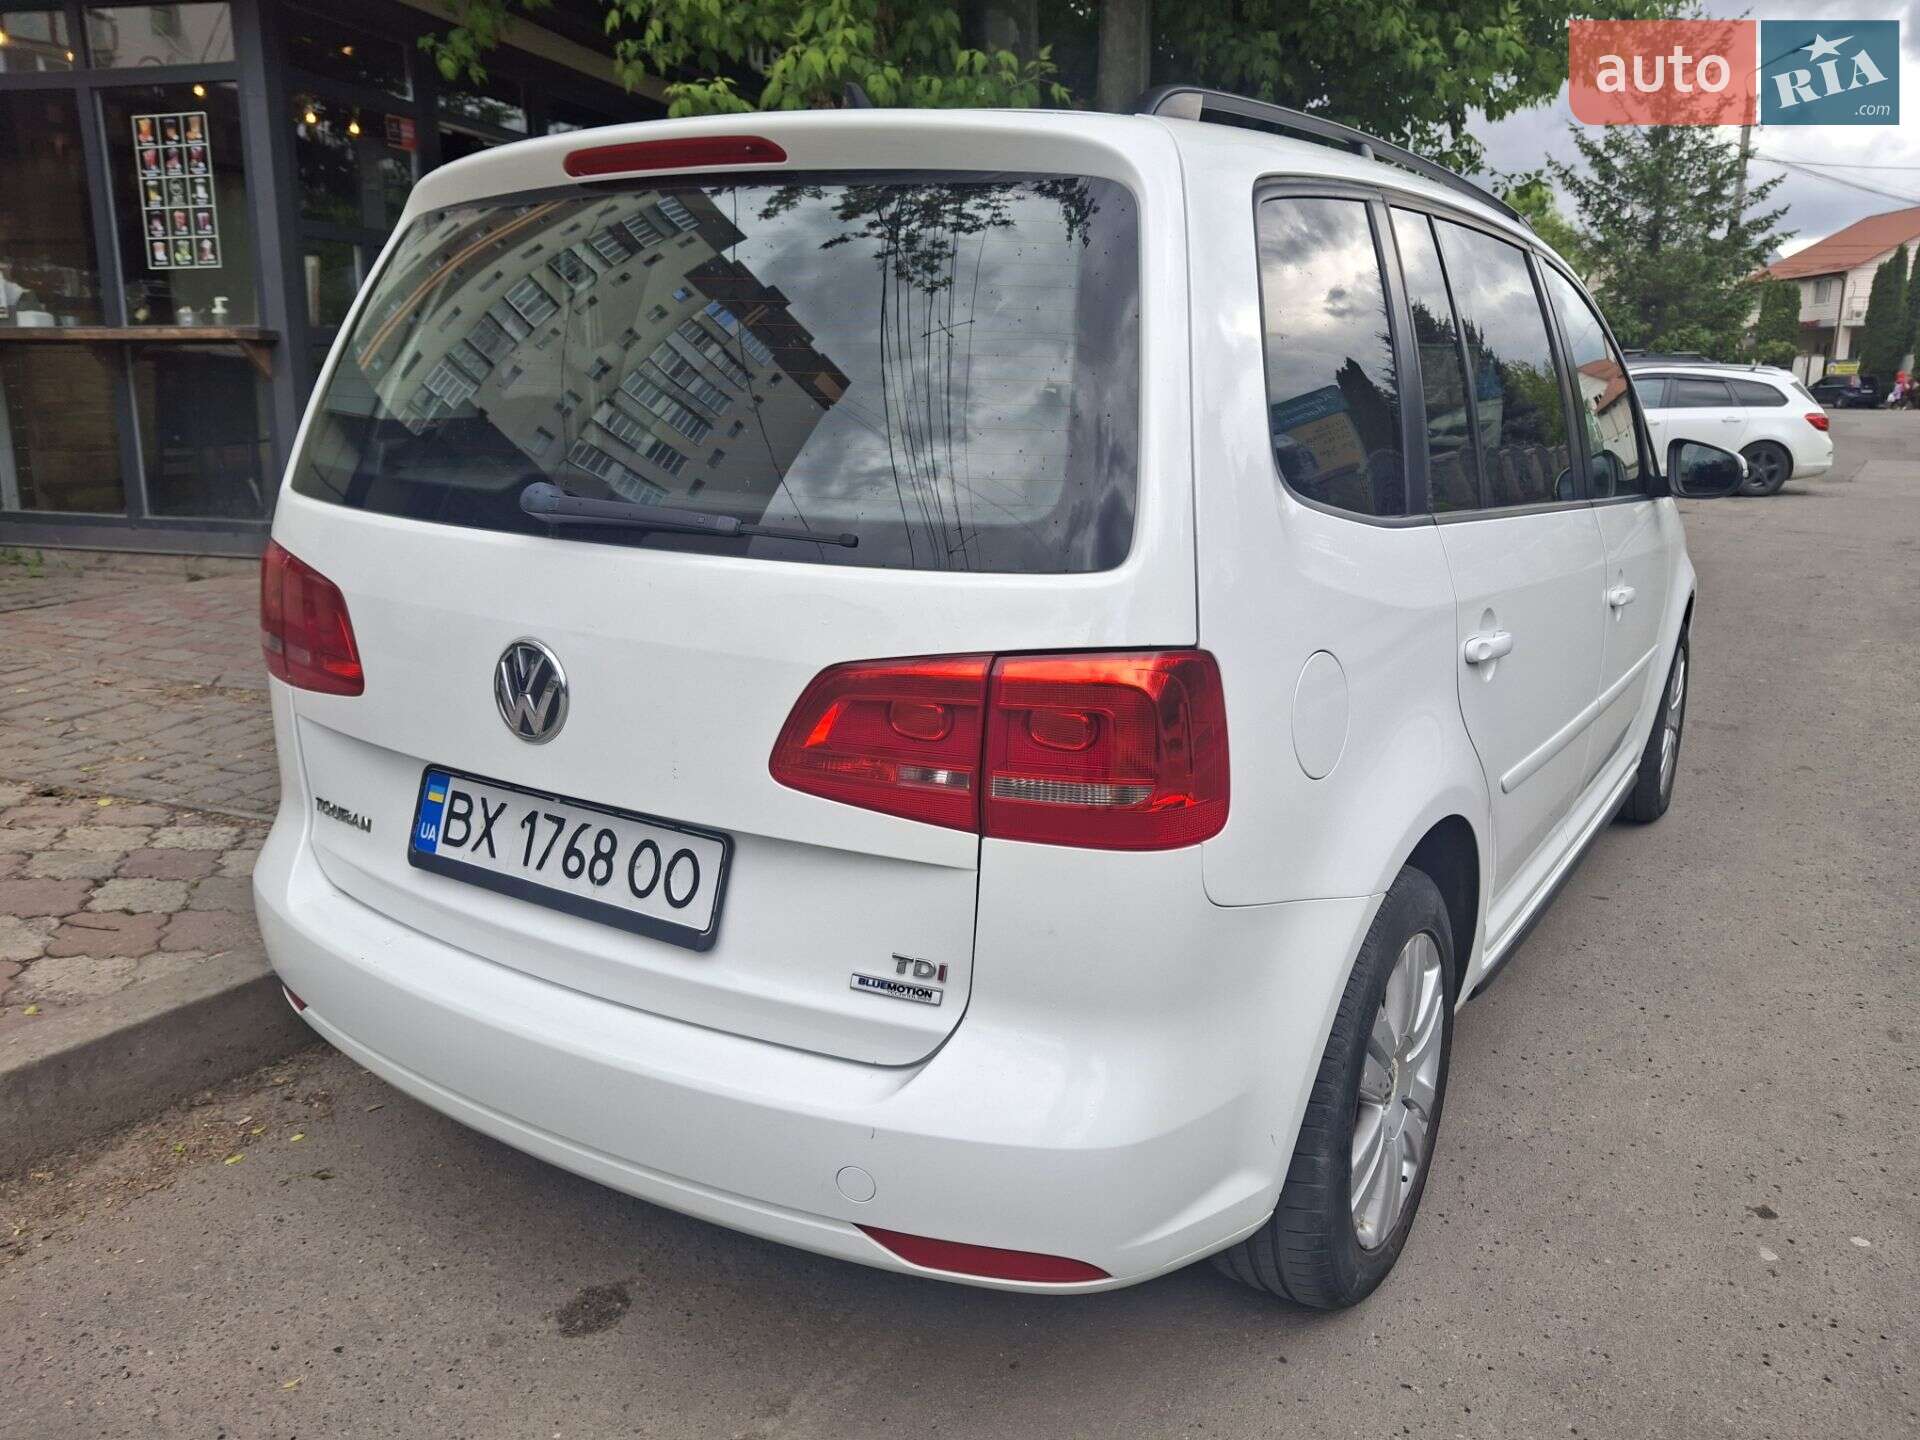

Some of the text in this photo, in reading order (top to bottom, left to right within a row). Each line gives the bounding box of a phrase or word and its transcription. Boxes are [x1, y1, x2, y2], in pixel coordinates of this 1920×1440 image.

[497, 640, 565, 742] VW
[420, 821, 436, 842] UA
[441, 789, 508, 859] BX
[520, 810, 618, 887] 1768
[892, 952, 948, 984] TDI
[857, 977, 933, 999] BLUEMOTION
